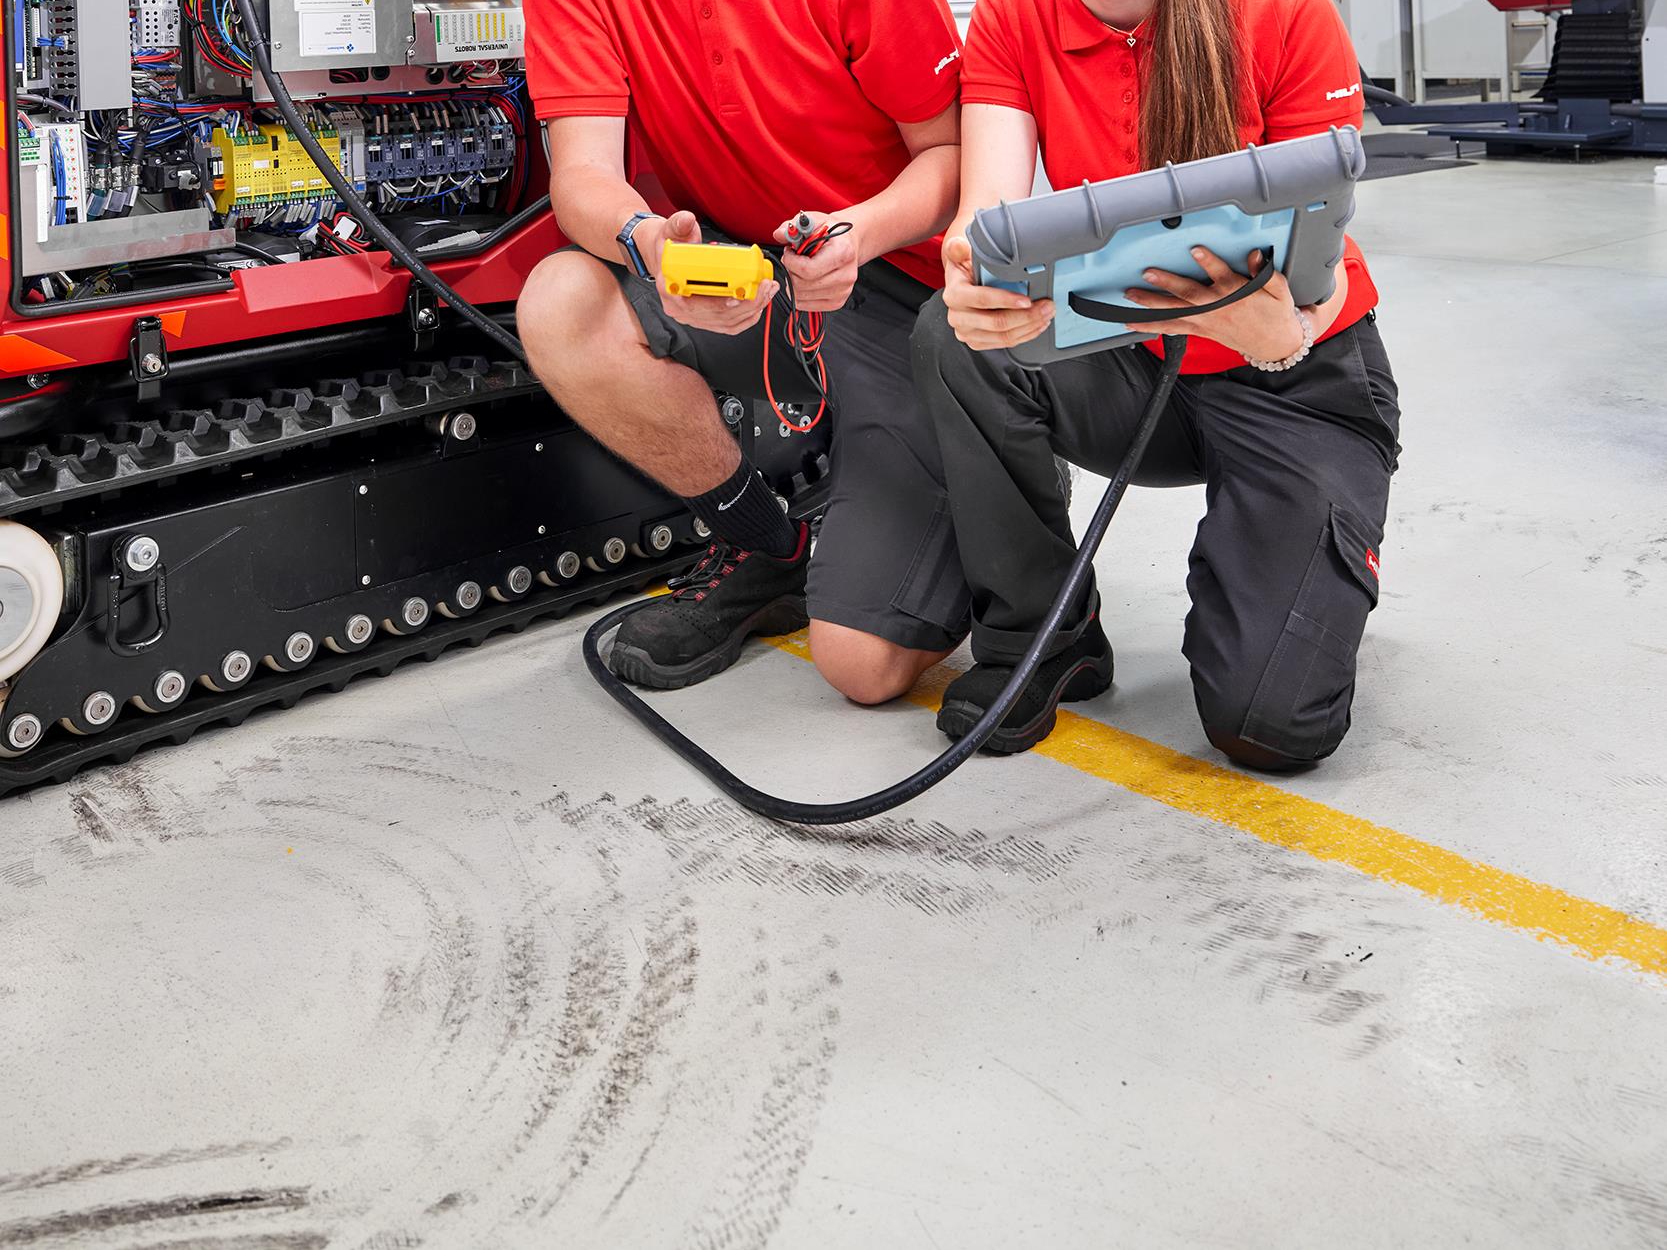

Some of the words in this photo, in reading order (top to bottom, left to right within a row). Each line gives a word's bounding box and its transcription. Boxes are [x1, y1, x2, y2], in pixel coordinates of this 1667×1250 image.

[454, 45, 477, 53] ROBOTS
[934, 48, 960, 75] HILT
[1326, 83, 1360, 100] HILT
